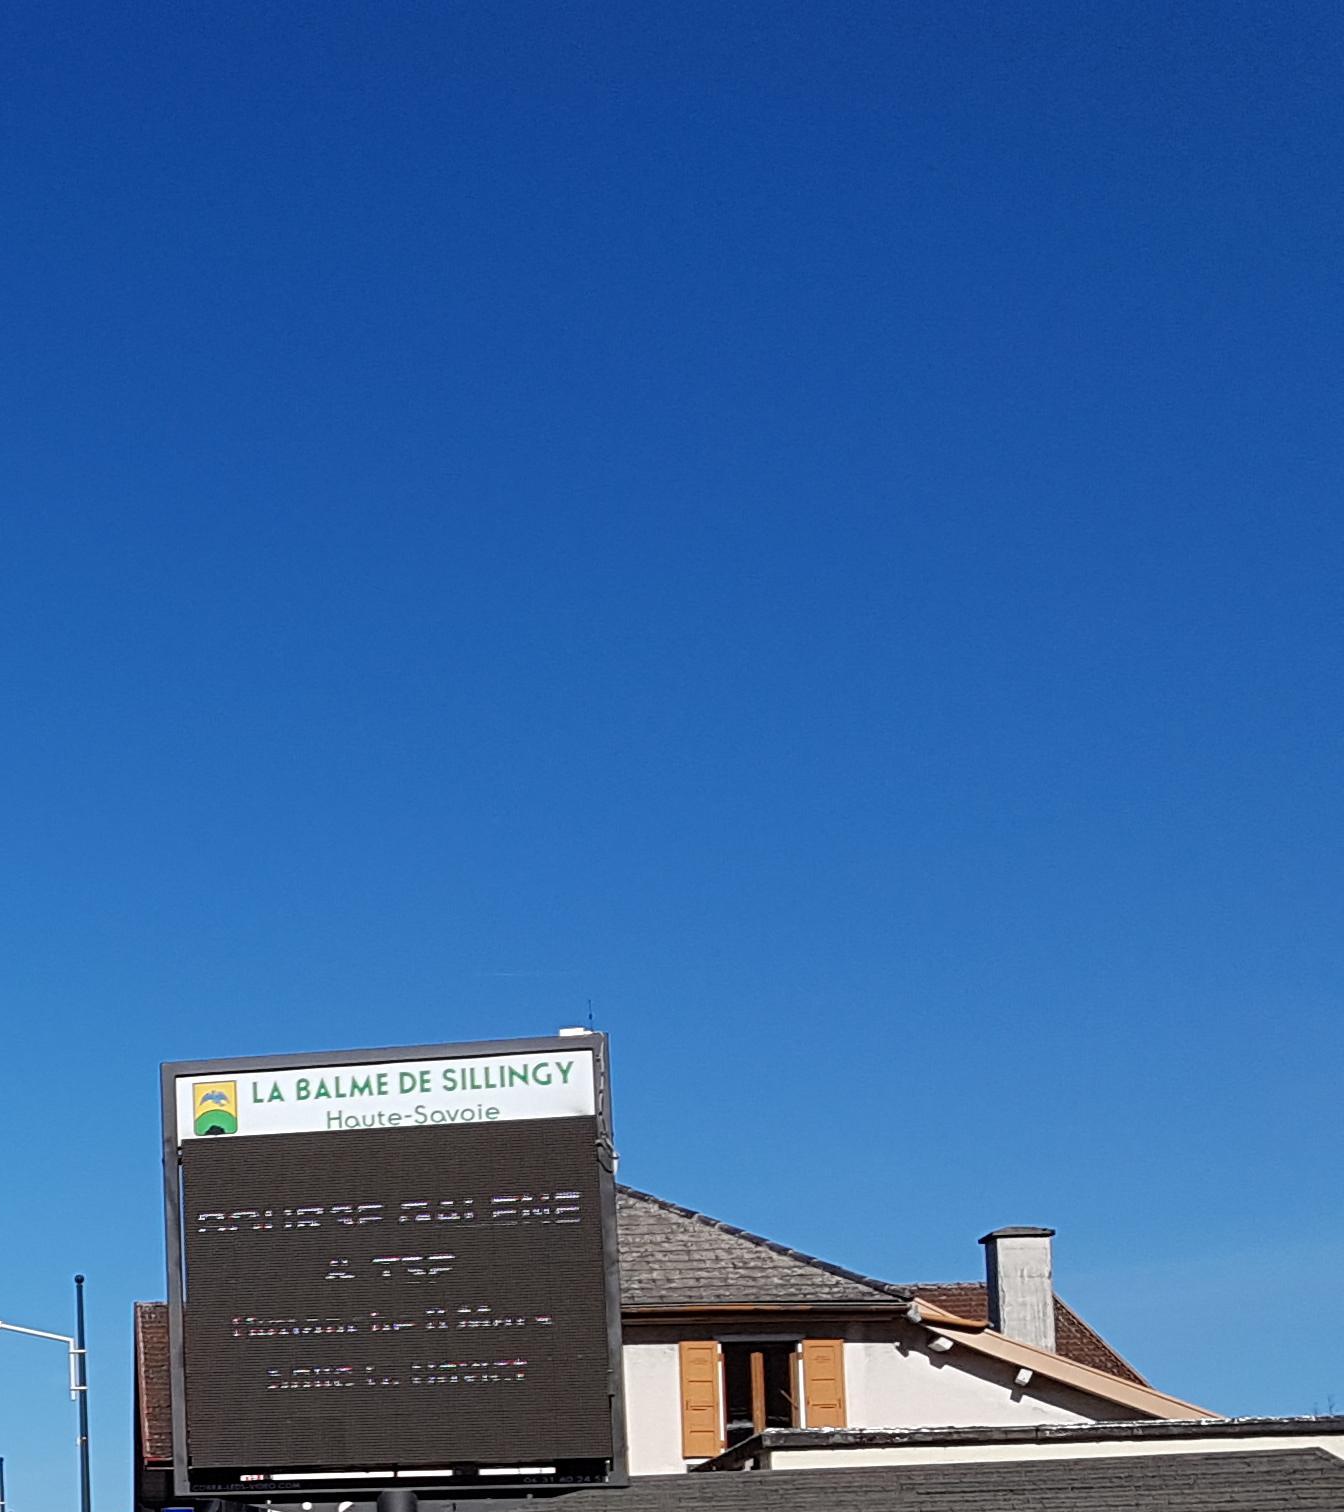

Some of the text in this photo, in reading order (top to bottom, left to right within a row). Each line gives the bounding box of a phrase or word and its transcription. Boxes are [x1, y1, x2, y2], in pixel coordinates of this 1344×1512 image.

[251, 1061, 575, 1103] LA BALME DE SILLINGY
[326, 1103, 501, 1130] Haute-Savoie
